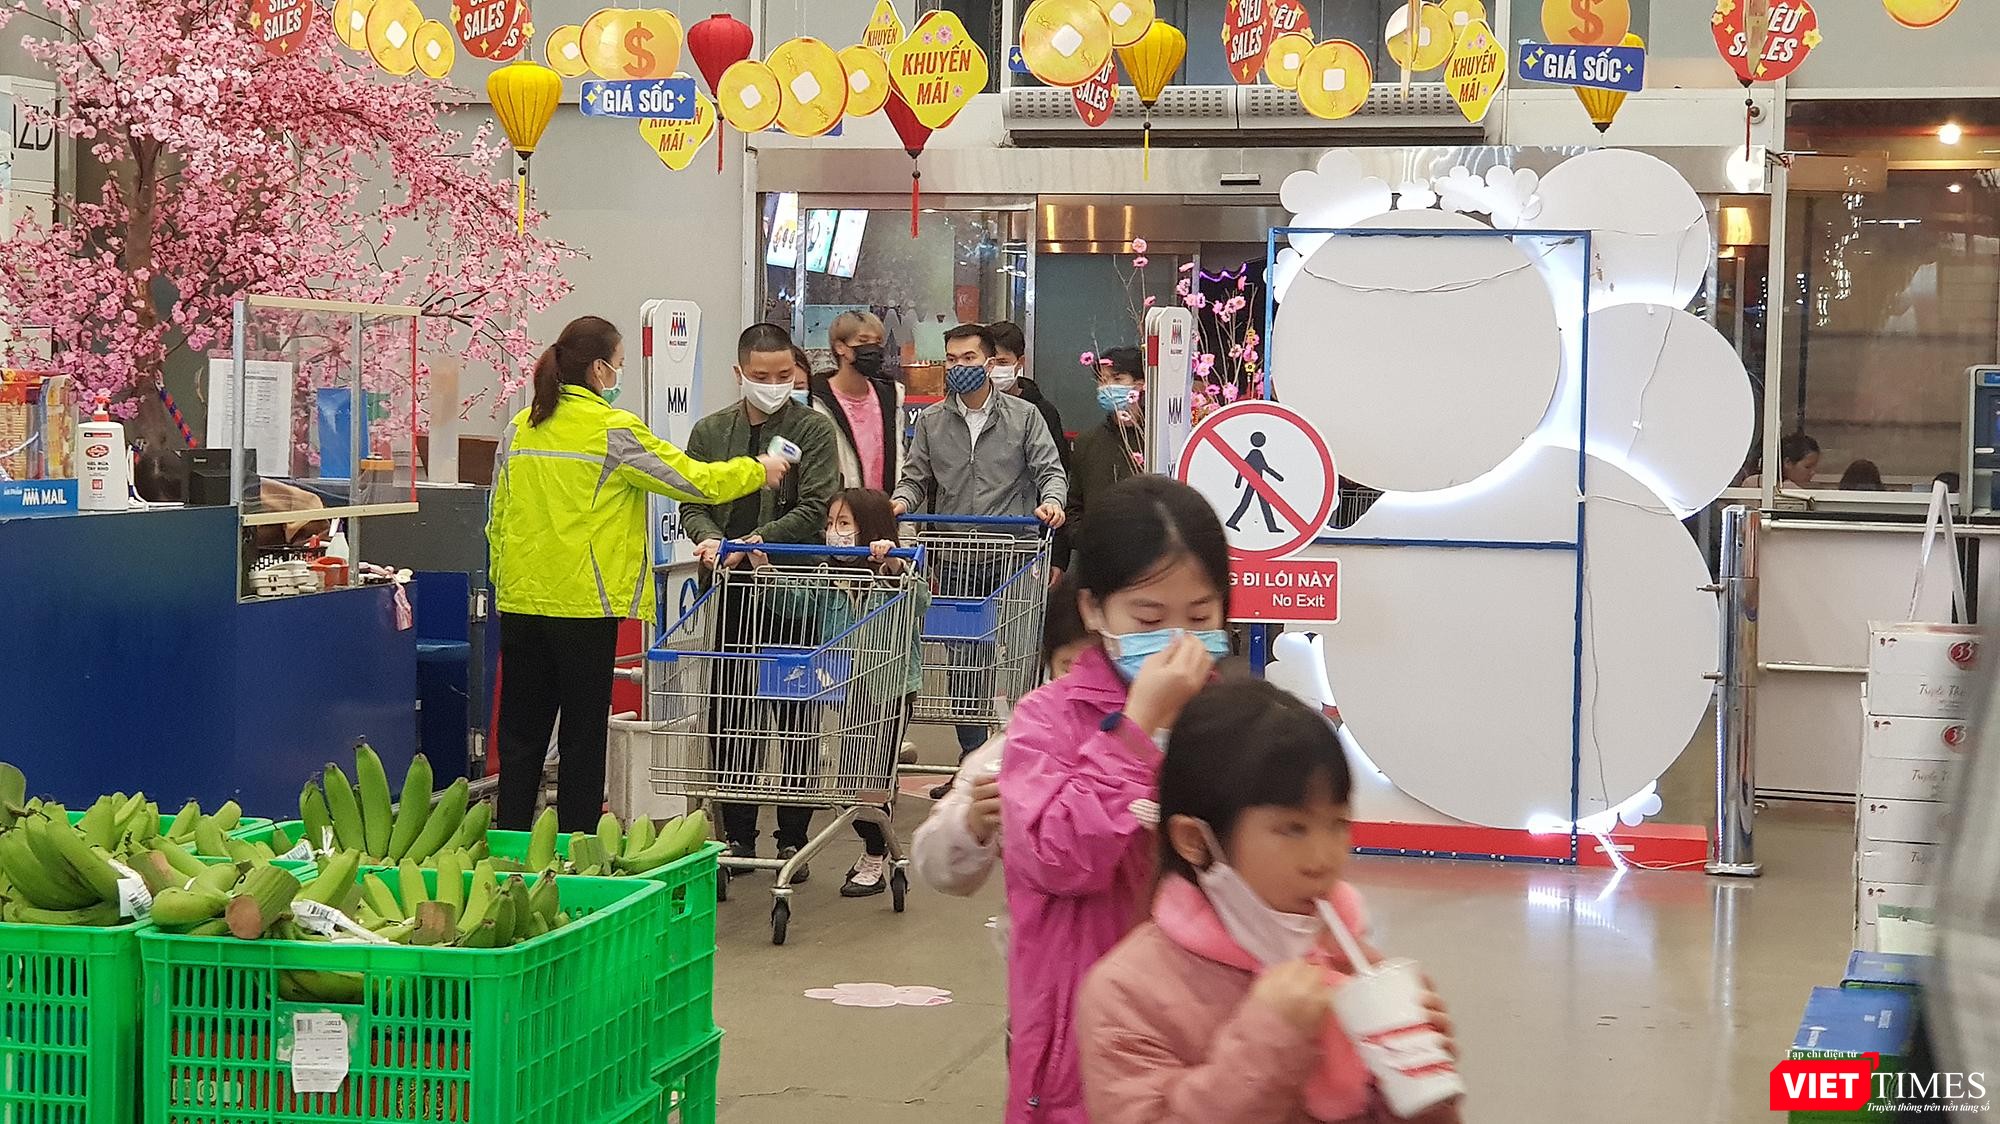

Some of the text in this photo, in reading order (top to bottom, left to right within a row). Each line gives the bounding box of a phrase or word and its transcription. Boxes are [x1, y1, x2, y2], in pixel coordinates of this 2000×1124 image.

[263, 7, 302, 42] SALES
[463, 0, 506, 41] SALES
[866, 21, 899, 47] KHUYẾN
[901, 39, 972, 76] KHUYẾN
[1230, 24, 1264, 63] SALES
[1728, 31, 1798, 62] SES
[1451, 44, 1497, 78] KHUYẾN
[1543, 47, 1622, 83] GIÁ SỐC
[602, 80, 675, 113] GIÁ SỐC
[916, 75, 950, 105] MÃI
[1075, 80, 1109, 111] SALES
[1458, 77, 1481, 103] MÃI
[658, 128, 685, 153] MÃI
[667, 386, 688, 414] MM
[1167, 396, 1183, 425] MM
[41, 489, 68, 506] MAIL
[1242, 571, 1260, 587] ĐI
[1297, 570, 1335, 588] NÀY
[1272, 593, 1326, 608] No Exit
